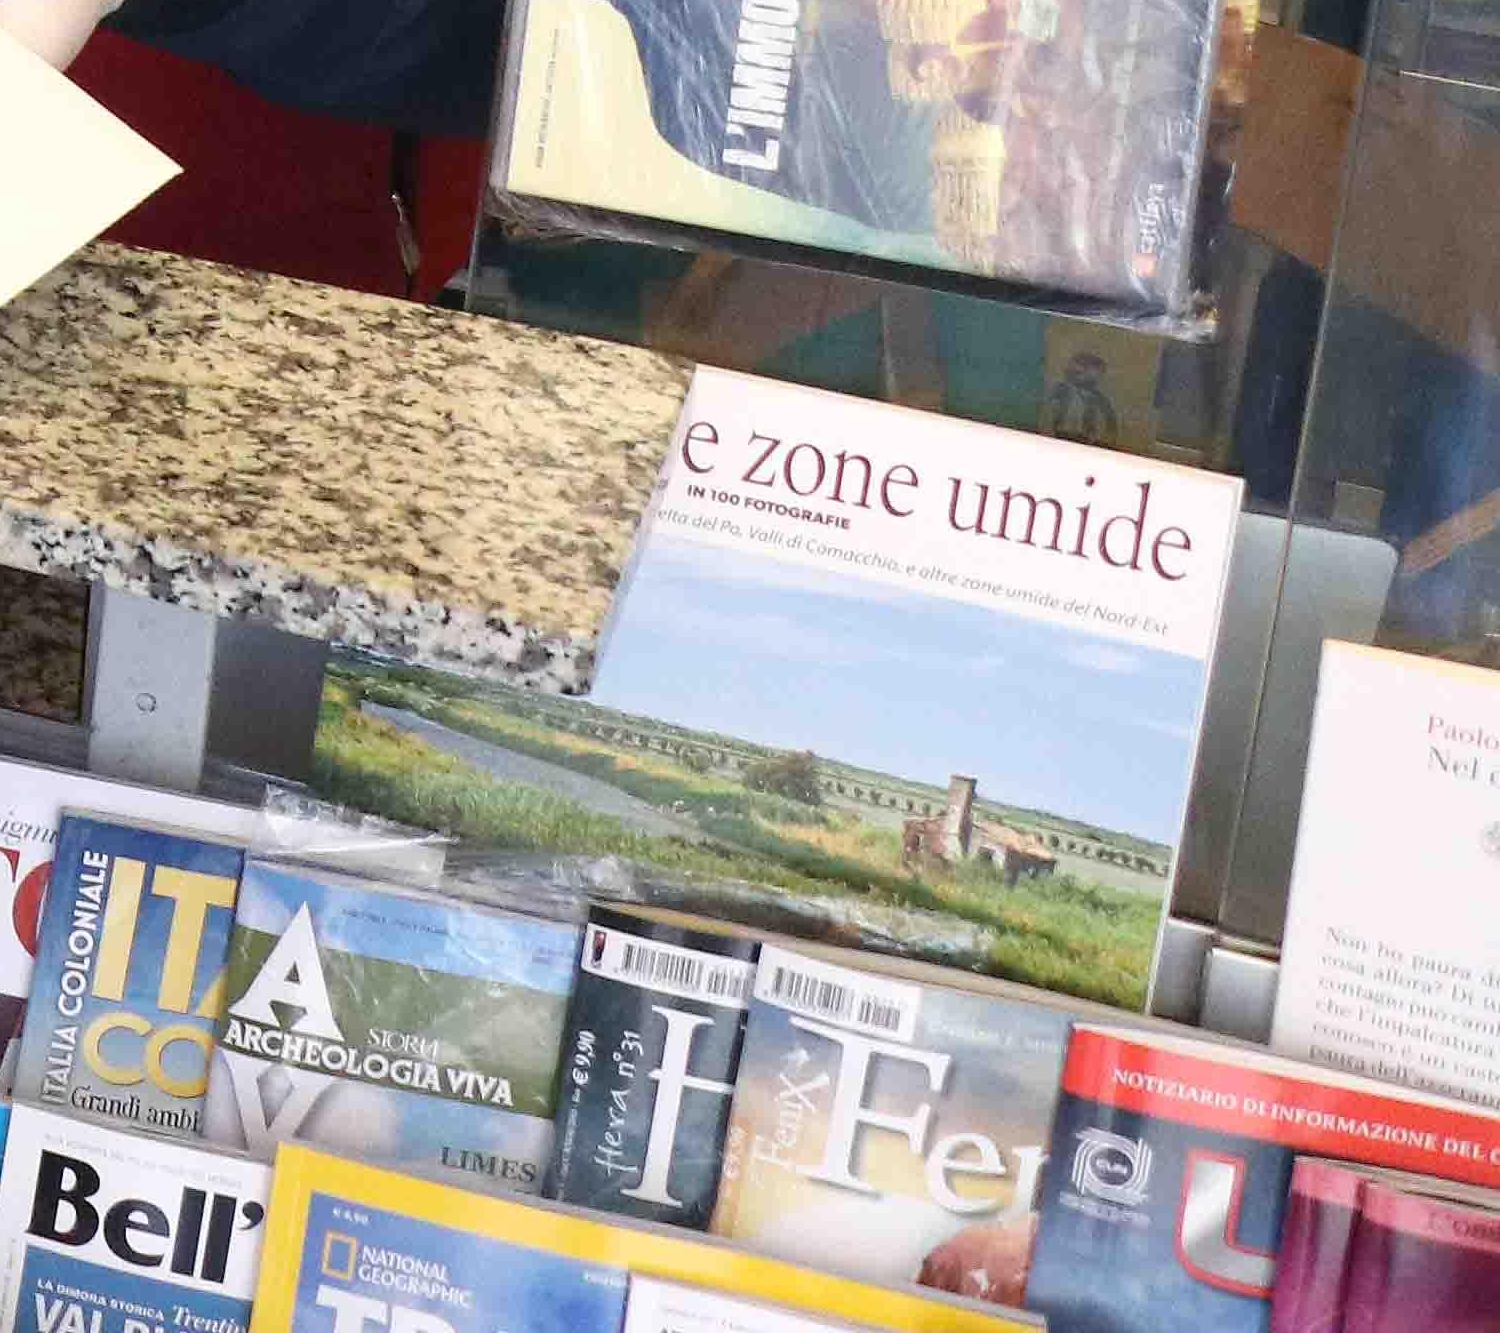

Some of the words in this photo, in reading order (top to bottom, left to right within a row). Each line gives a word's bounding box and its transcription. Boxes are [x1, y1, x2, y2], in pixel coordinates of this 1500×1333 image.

[741, 431, 919, 518] zone
[947, 474, 1192, 583] umide
[744, 496, 851, 531] FOTOGRAFIE
[58, 850, 110, 1015] COLONIALE
[41, 1019, 78, 1103] ITALIA
[70, 1084, 141, 1119] Grandi
[223, 1020, 440, 1091] ARCHEOLOGIA
[445, 1069, 513, 1107] VIVA
[1111, 1066, 1238, 1112] NOTIZIARIO
[1271, 1102, 1437, 1153] INFORMAZIONE
[442, 1147, 536, 1182] LIMES
[27, 1148, 266, 1284] Bell'
[357, 1262, 472, 1306] GEOGRAPHIC
[360, 1245, 450, 1281] NATIONAL
